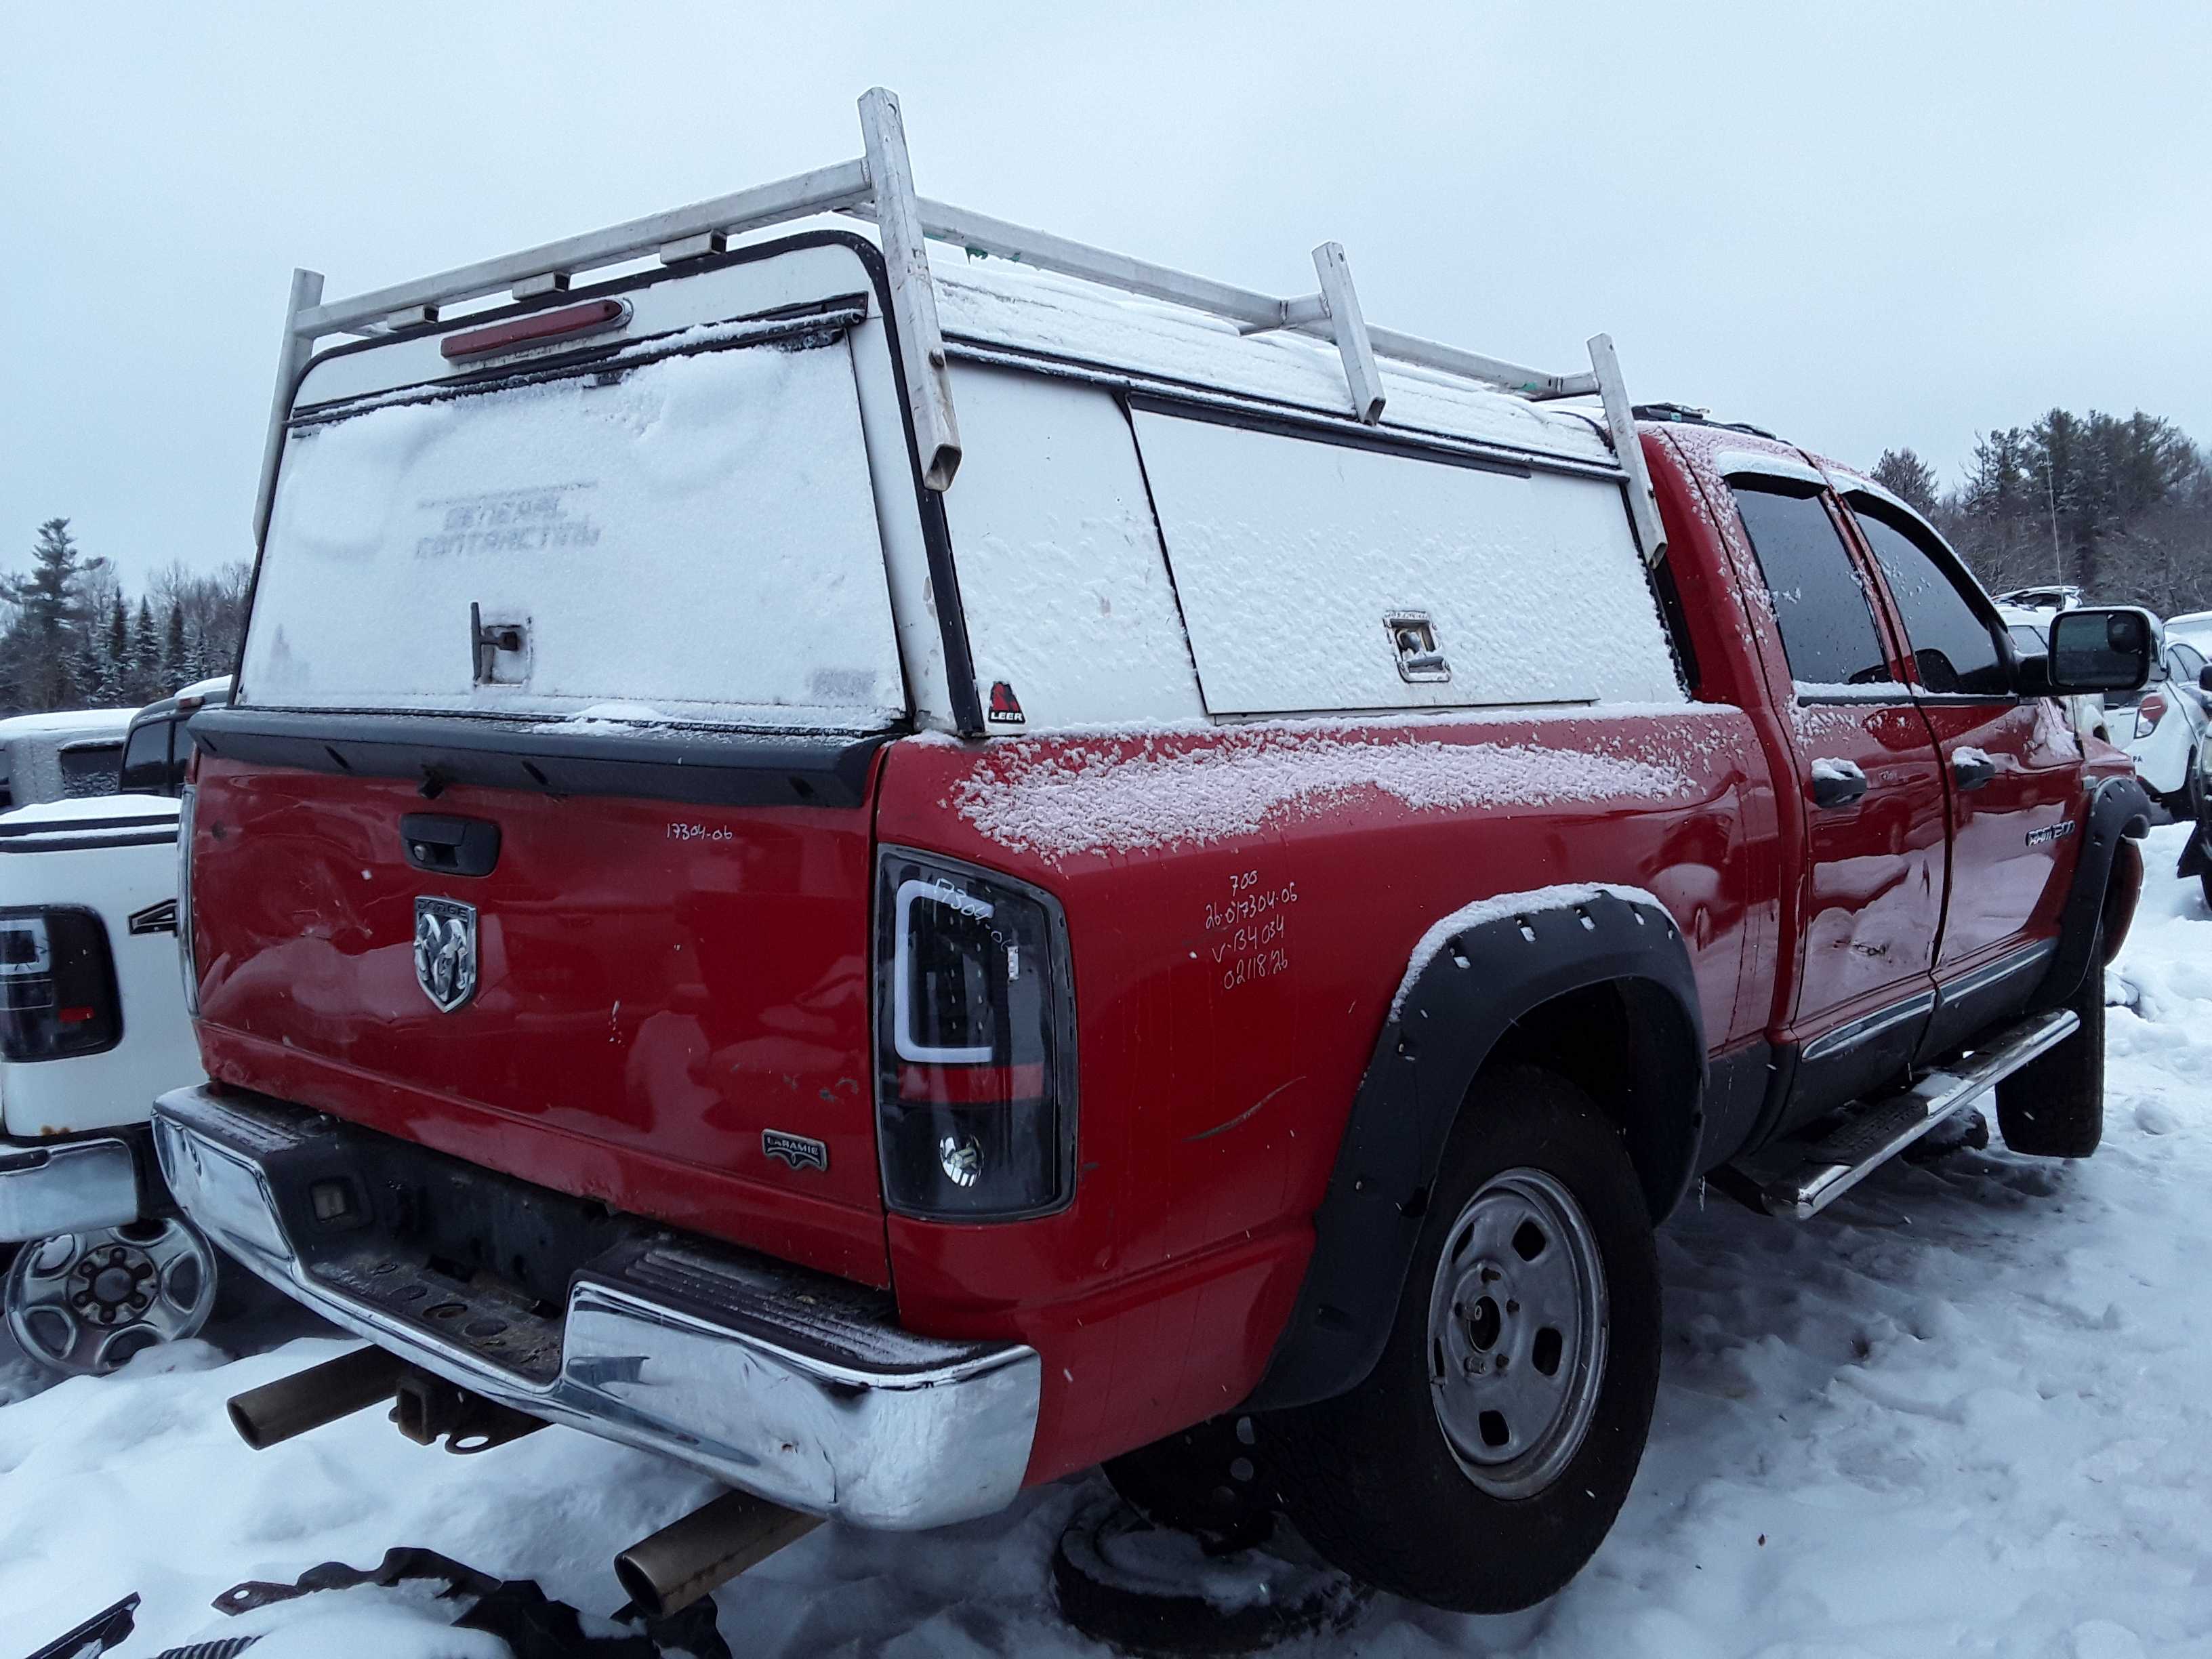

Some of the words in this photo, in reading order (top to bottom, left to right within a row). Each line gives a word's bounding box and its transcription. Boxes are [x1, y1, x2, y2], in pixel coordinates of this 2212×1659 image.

[990, 712, 1023, 722] LEER
[666, 823, 733, 840] 17304-06
[766, 1136, 819, 1155] LARAMIE
